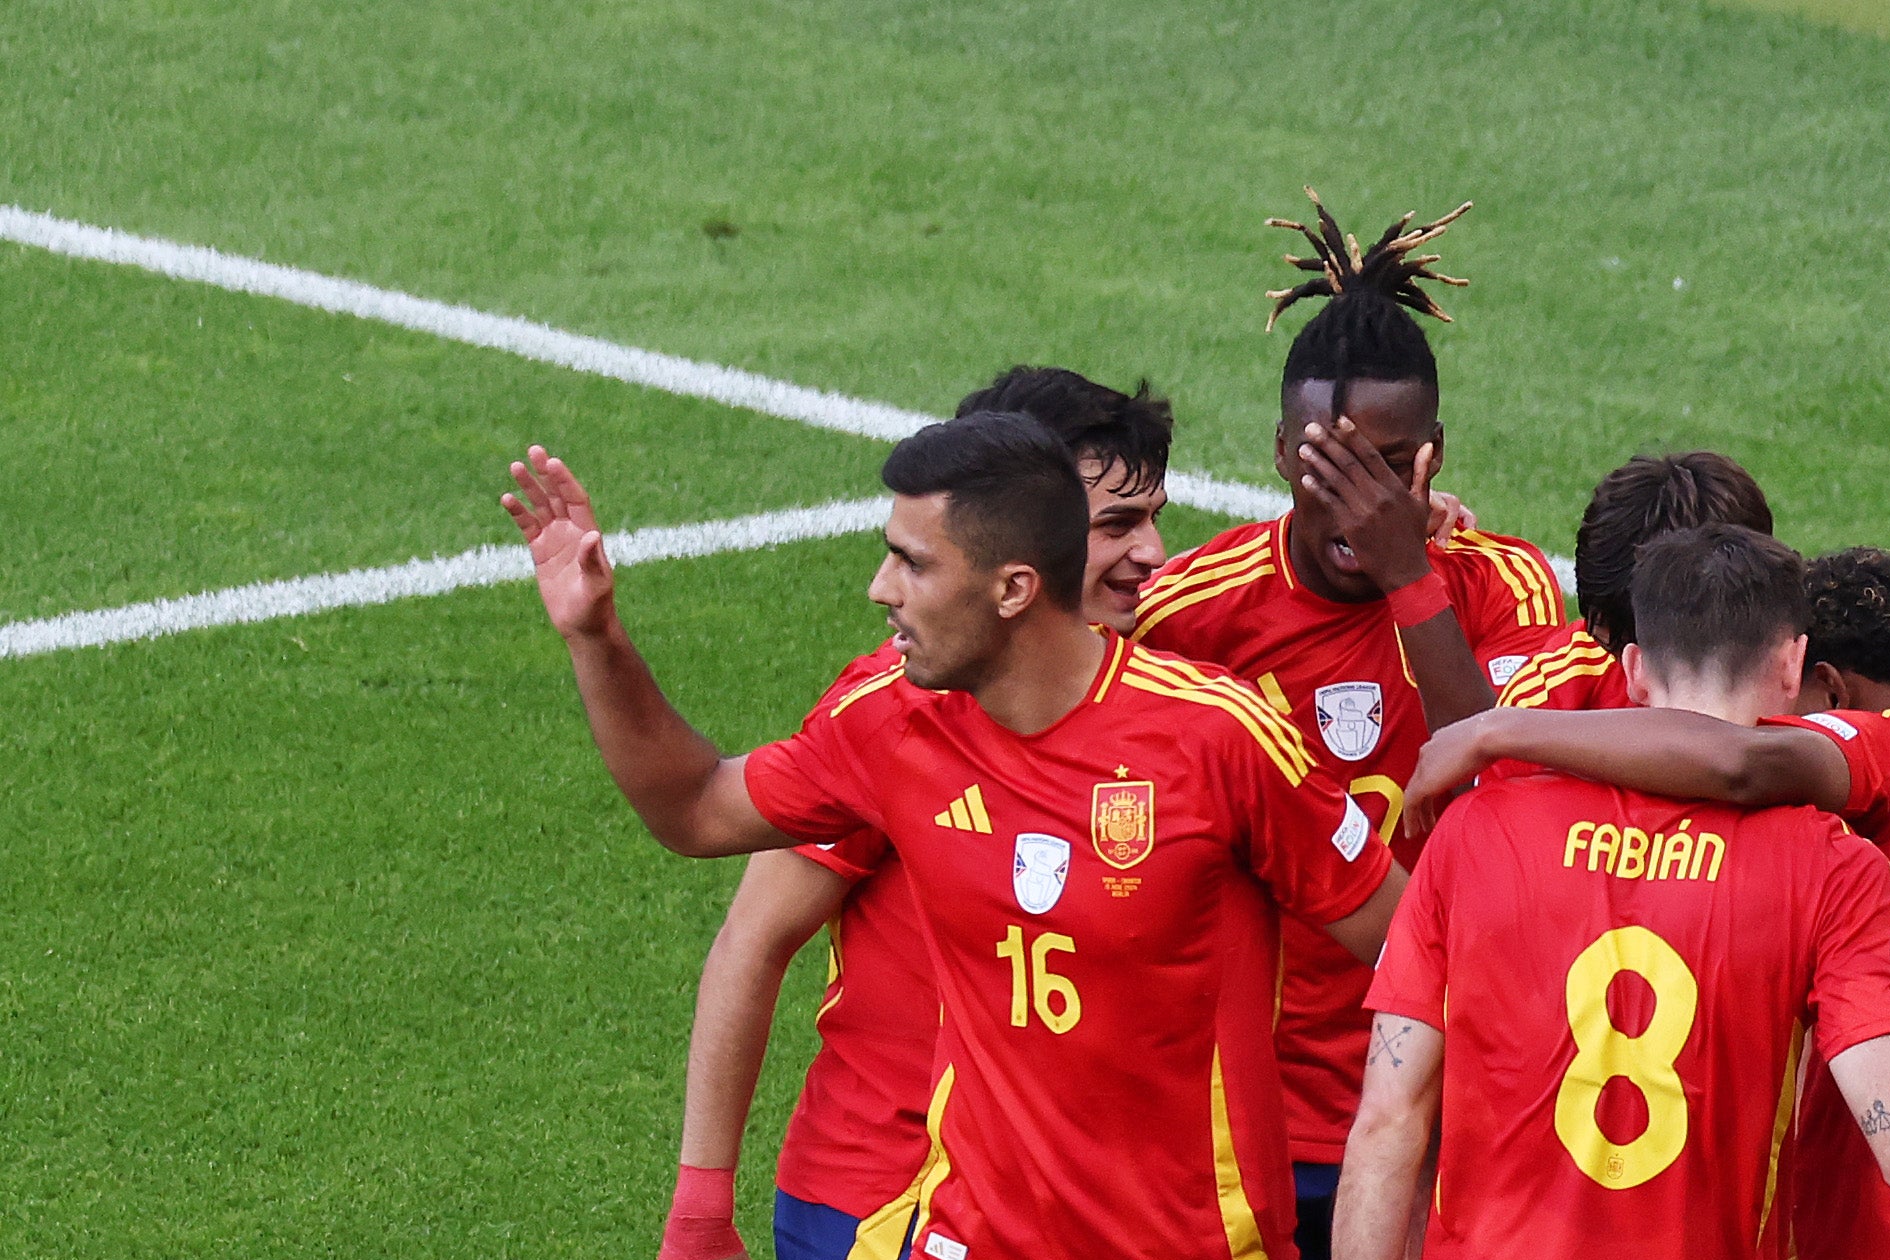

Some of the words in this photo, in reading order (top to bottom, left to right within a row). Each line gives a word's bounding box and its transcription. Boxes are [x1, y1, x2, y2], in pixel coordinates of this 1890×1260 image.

[1563, 818, 1726, 882] FABIÁN
[996, 924, 1082, 1035] 16
[1554, 925, 1698, 1190] 8
